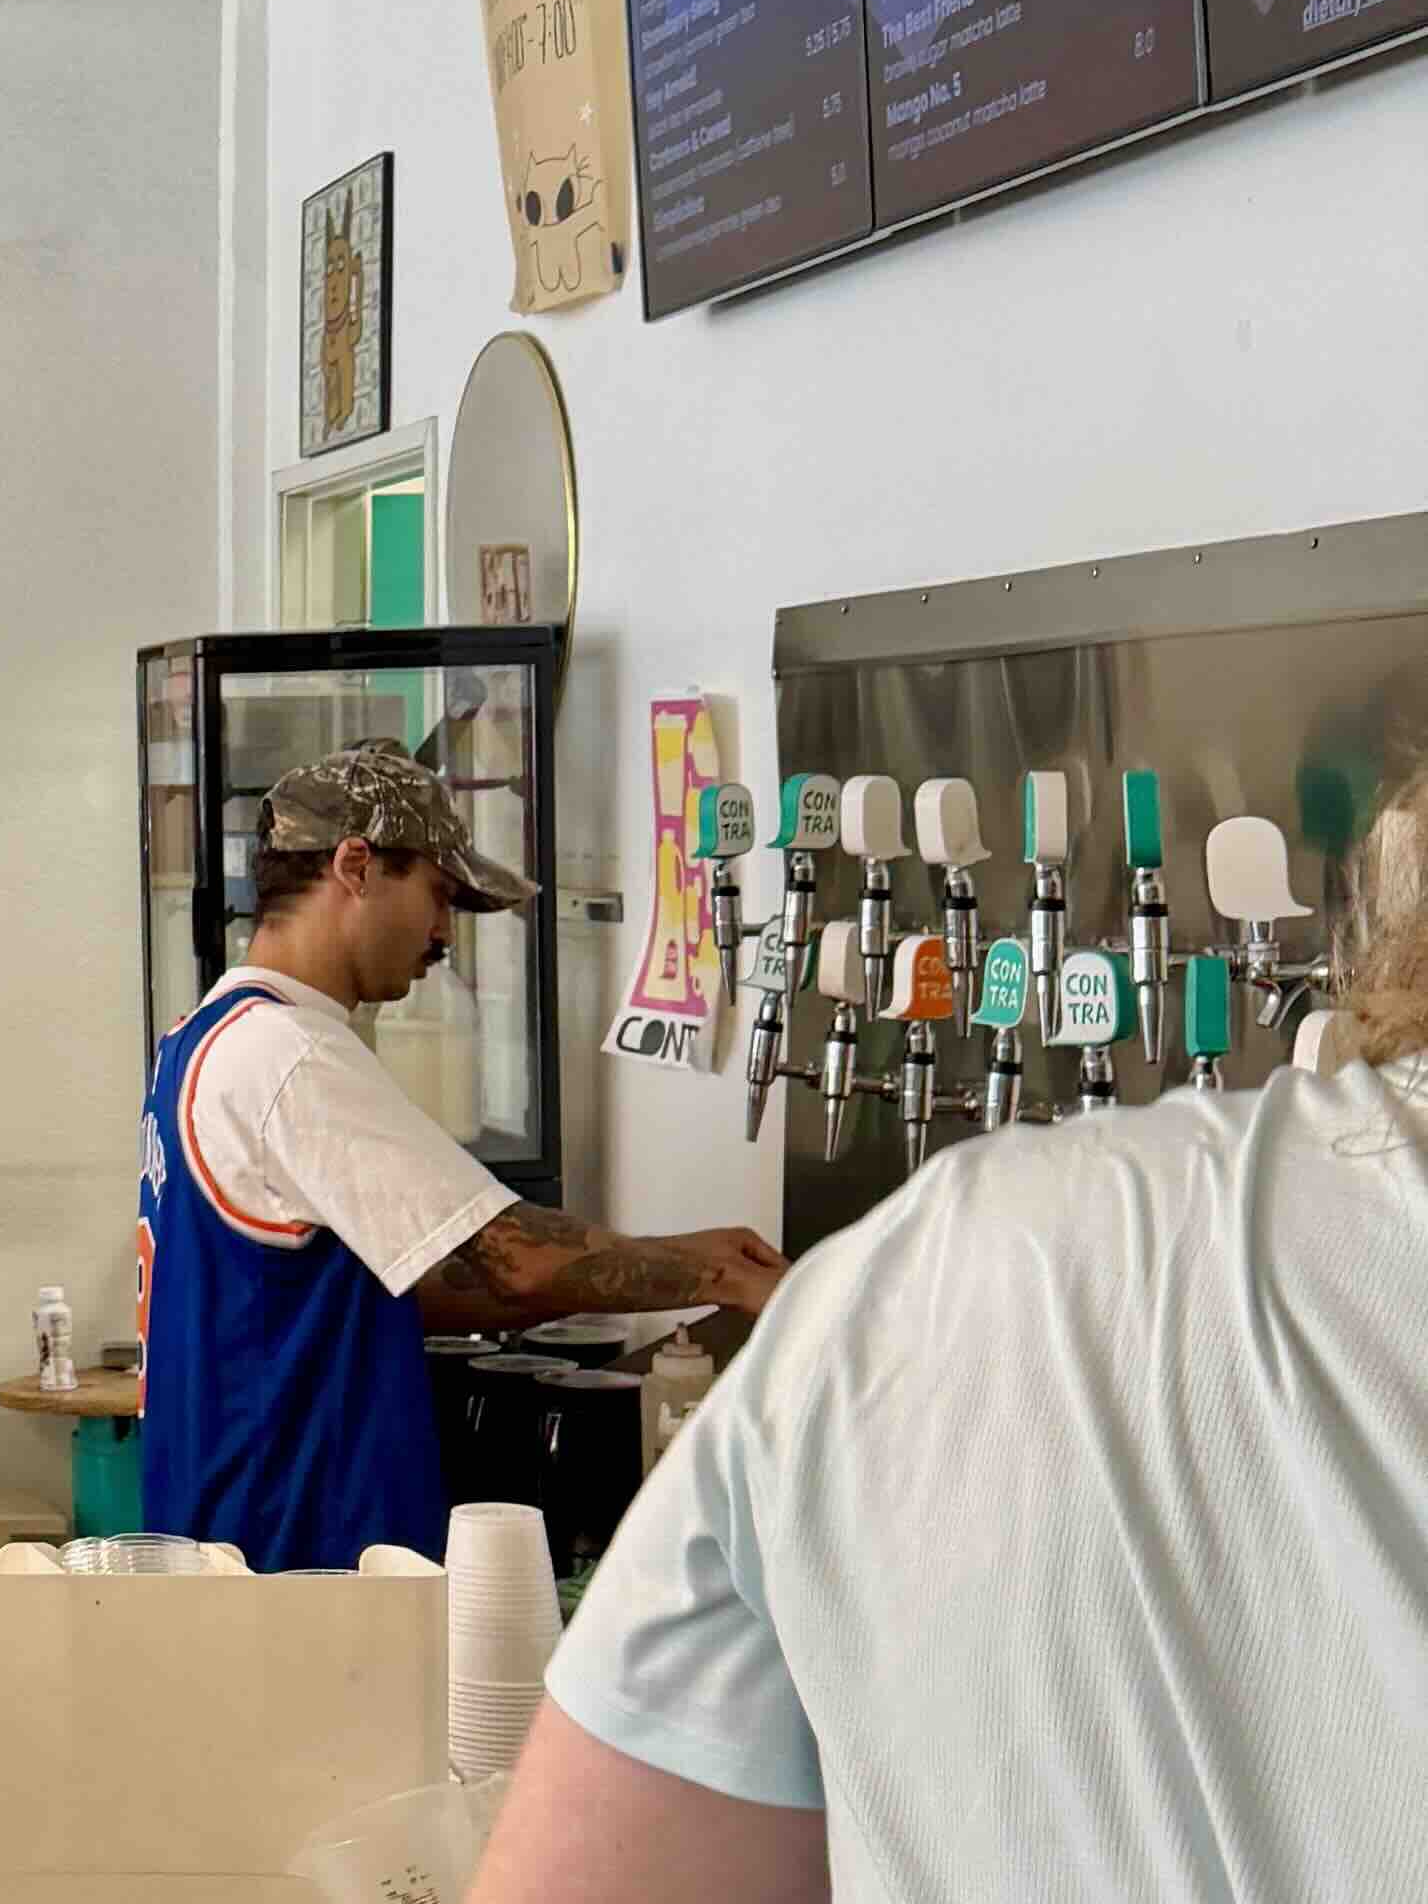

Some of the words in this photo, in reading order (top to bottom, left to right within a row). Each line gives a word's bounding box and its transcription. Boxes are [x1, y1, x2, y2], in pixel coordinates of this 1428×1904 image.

[882, 18, 902, 48] The
[905, 3, 931, 36] Best
[886, 90, 927, 134] Mango
[952, 70, 961, 97] 5
[718, 799, 749, 819] CON
[802, 790, 836, 811] CON
[720, 822, 752, 841] TRA
[801, 814, 834, 834] TRA
[990, 957, 1021, 981] CON
[1065, 974, 1108, 996] CON
[989, 986, 1019, 1009] TRA
[1067, 1002, 1110, 1025] TRA
